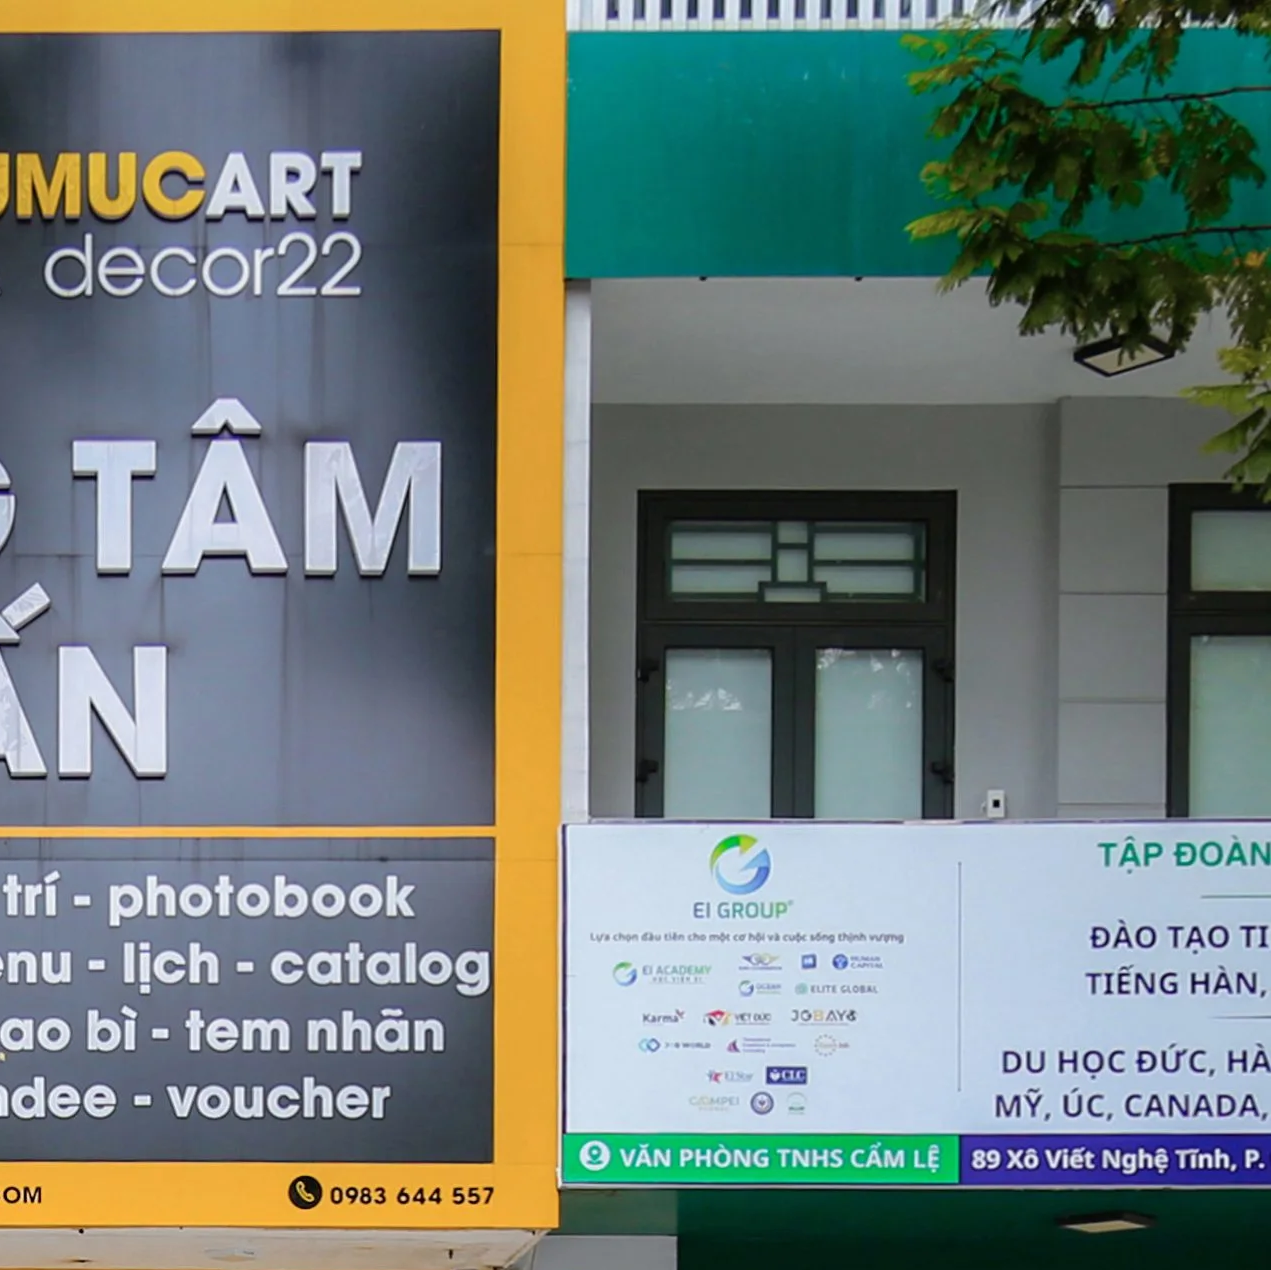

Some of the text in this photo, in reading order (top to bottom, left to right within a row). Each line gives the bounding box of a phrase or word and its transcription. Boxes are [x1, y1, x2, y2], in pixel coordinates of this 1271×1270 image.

[45, 232, 361, 297] decor22
[73, 397, 442, 577] TÂM
[1098, 834, 1271, 873] TẬP ĐOÀN
[3, 871, 61, 918] trí
[107, 875, 416, 928] photobook
[693, 902, 711, 919] EI
[1090, 920, 1157, 948] ĐÀO
[1168, 926, 1230, 955] TẠO
[123, 941, 220, 994] lịch
[270, 942, 491, 996] catalog
[656, 965, 712, 976] ACADEMY
[1086, 965, 1267, 999] TIẾNG HÀN,
[810, 985, 878, 994] ELITE GLOBAL
[86, 1005, 138, 1052] bì
[185, 1010, 287, 1052] tem
[307, 1007, 445, 1052] nhãn
[642, 1012, 679, 1023] Karma
[1002, 1051, 1045, 1073] DU
[1059, 1051, 1126, 1079] HỌC
[1137, 1045, 1216, 1077] ĐỨC,
[167, 1077, 391, 1120] voucher
[995, 1087, 1267, 1121] MỸ, ÚC, CANADA,
[620, 1143, 940, 1173] VĂN PHÒNG TNHS CẨM LỆ
[972, 1147, 1264, 1174] 89 Xô Viết Nghệ Tĩnh, P.
[331, 1187, 495, 1206] 0983 644 557
